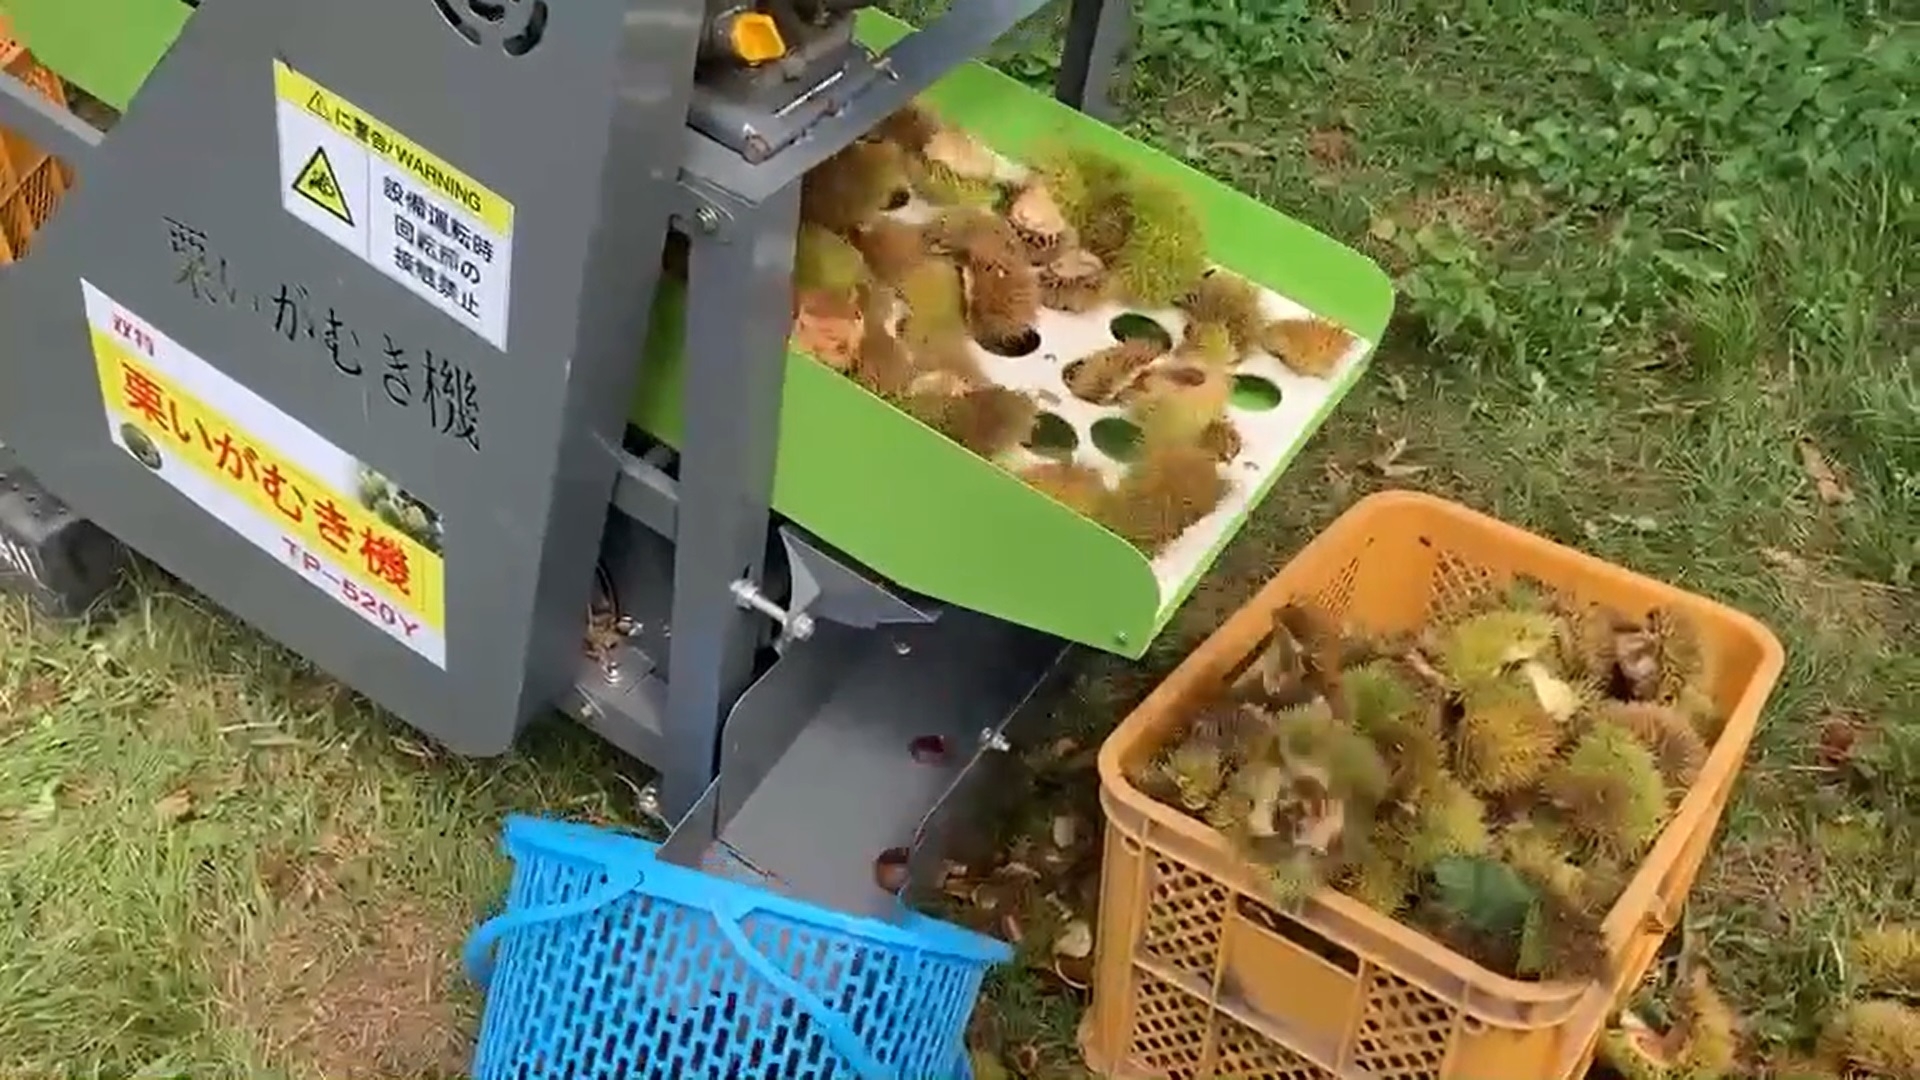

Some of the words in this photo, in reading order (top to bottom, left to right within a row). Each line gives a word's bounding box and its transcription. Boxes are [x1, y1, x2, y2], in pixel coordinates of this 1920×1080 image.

[121, 361, 410, 596] 栗いがむき機
[281, 536, 419, 637] TP-520Y
